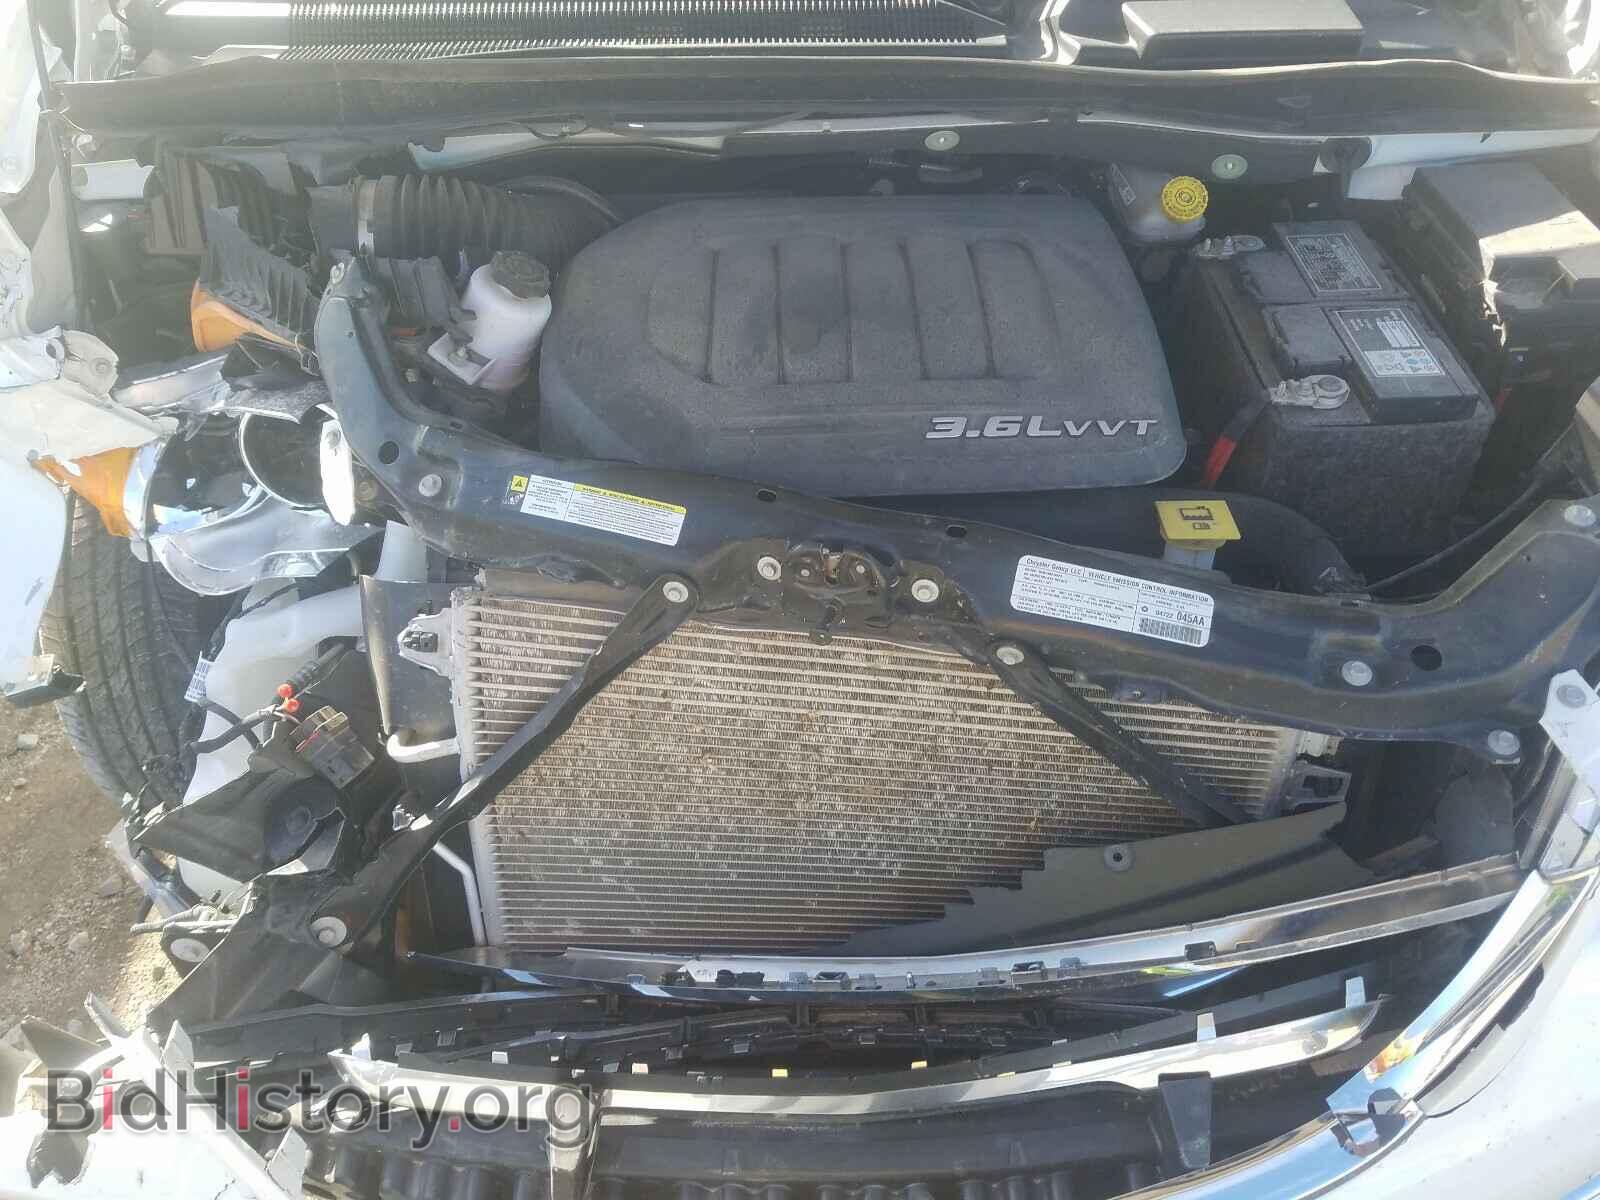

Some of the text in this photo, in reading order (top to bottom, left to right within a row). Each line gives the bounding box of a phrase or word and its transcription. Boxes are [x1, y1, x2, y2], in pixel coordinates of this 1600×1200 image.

[1088, 571, 1111, 582] VEHICLE
[1112, 575, 1140, 587] EMISSION
[1141, 582, 1167, 594] CONTROL
[1168, 589, 1209, 602] INFORMATION
[1176, 610, 1205, 627] 045AA
